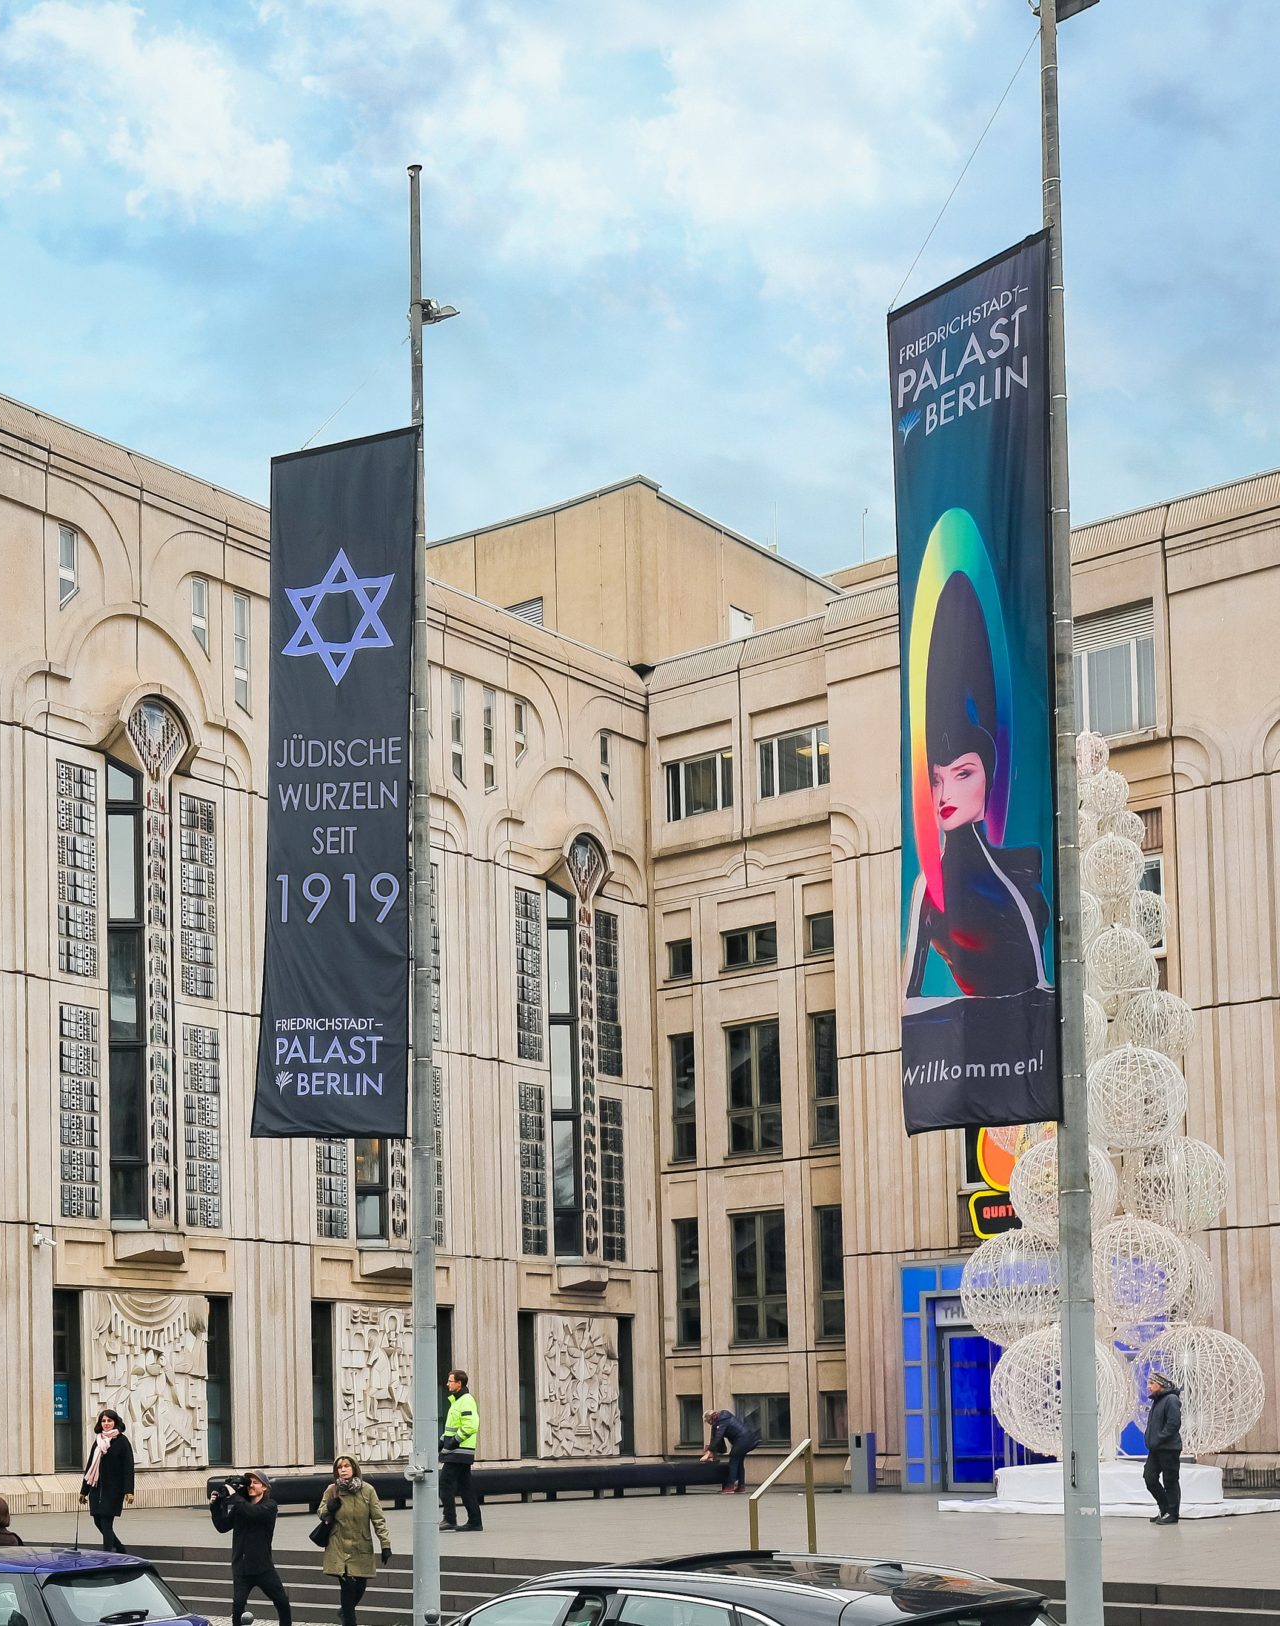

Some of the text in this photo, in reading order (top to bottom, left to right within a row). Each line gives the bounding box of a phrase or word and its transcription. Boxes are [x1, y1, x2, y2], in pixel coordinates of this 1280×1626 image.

[899, 284, 1029, 365] FRIEDRICHSTADT-
[897, 304, 1028, 409] PALAST
[925, 355, 1028, 437] BERLIN
[276, 734, 402, 768] JÜDISCHE
[278, 780, 399, 812] WURZELN
[311, 826, 358, 855] SEIT
[276, 872, 400, 925] 1919
[275, 1018, 384, 1032] FRIEDRICHSTADT-
[275, 1035, 384, 1065] PALAST
[297, 1072, 383, 1096] BERLIN
[903, 1049, 1044, 1086] Willkommen!
[982, 1204, 1017, 1220] QUAT
